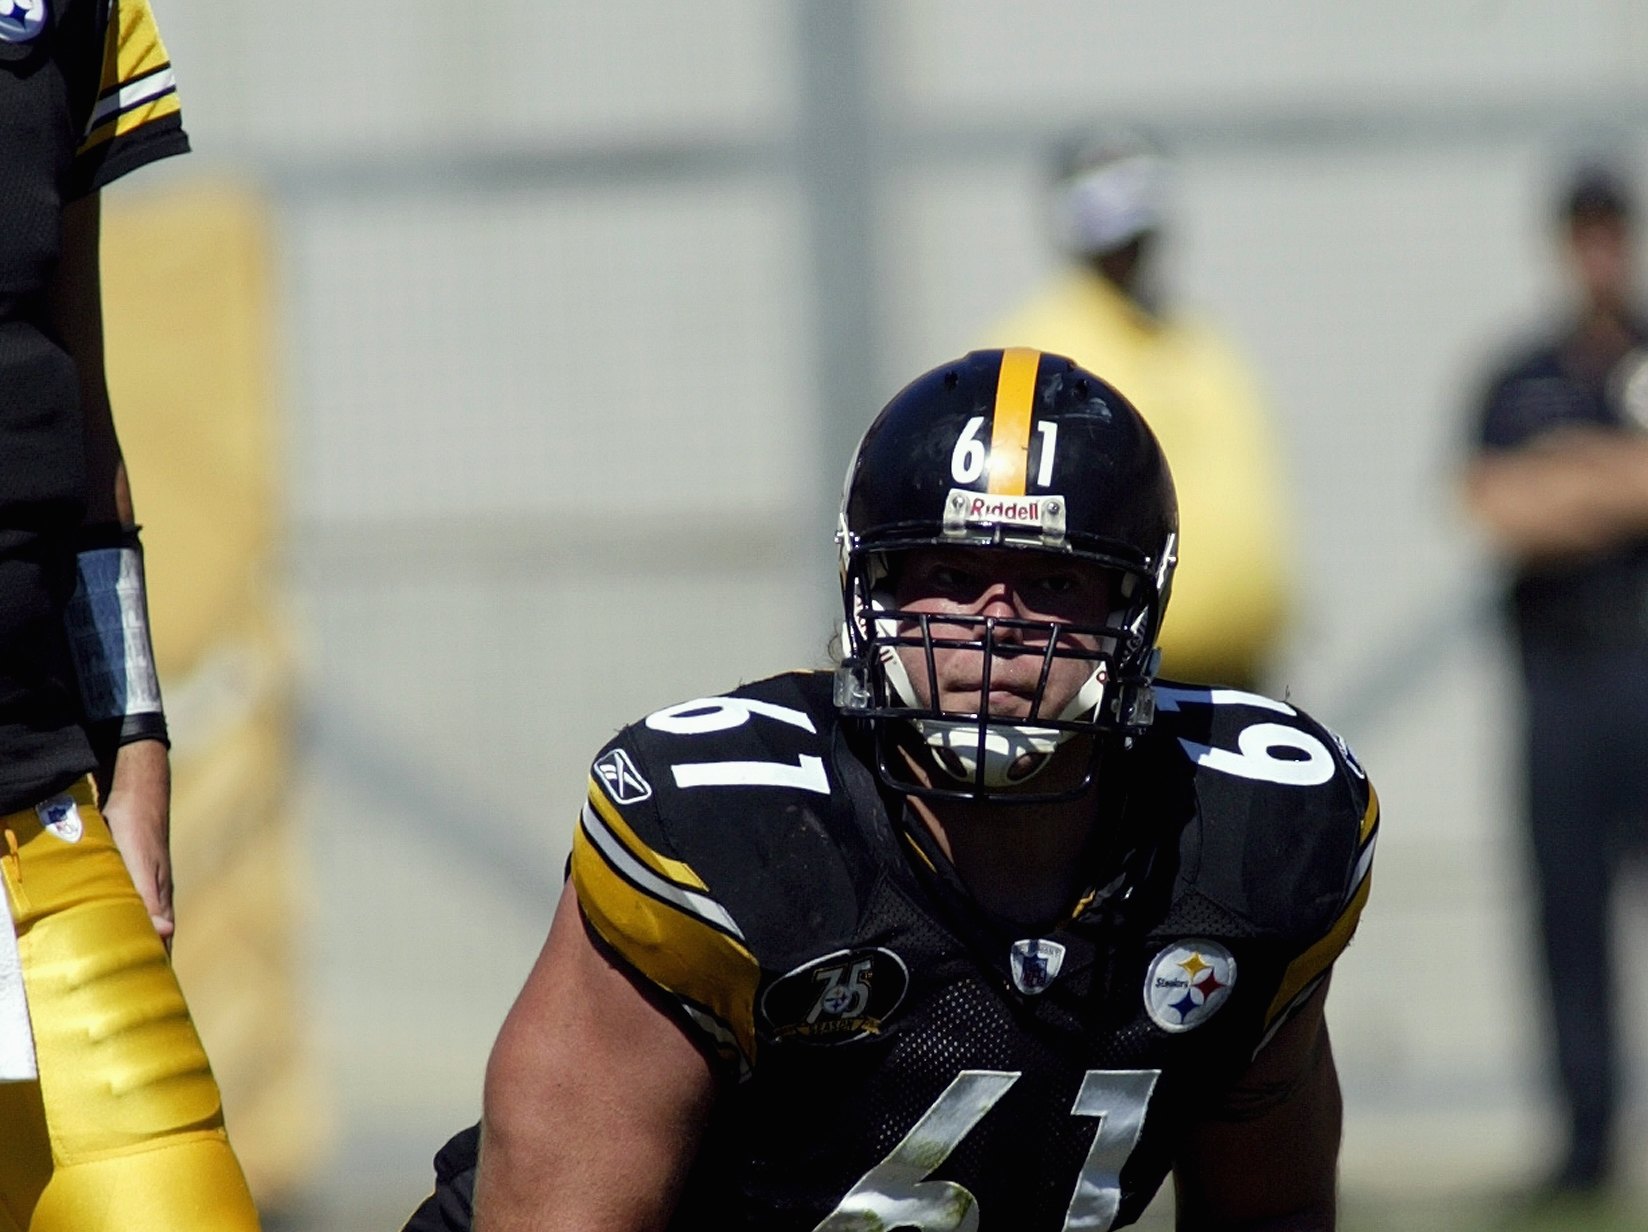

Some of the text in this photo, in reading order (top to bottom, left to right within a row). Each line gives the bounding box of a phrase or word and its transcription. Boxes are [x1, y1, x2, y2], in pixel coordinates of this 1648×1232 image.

[969, 498, 1039, 520] Riddell
[645, 696, 831, 795] 61
[806, 959, 872, 1024] 75
